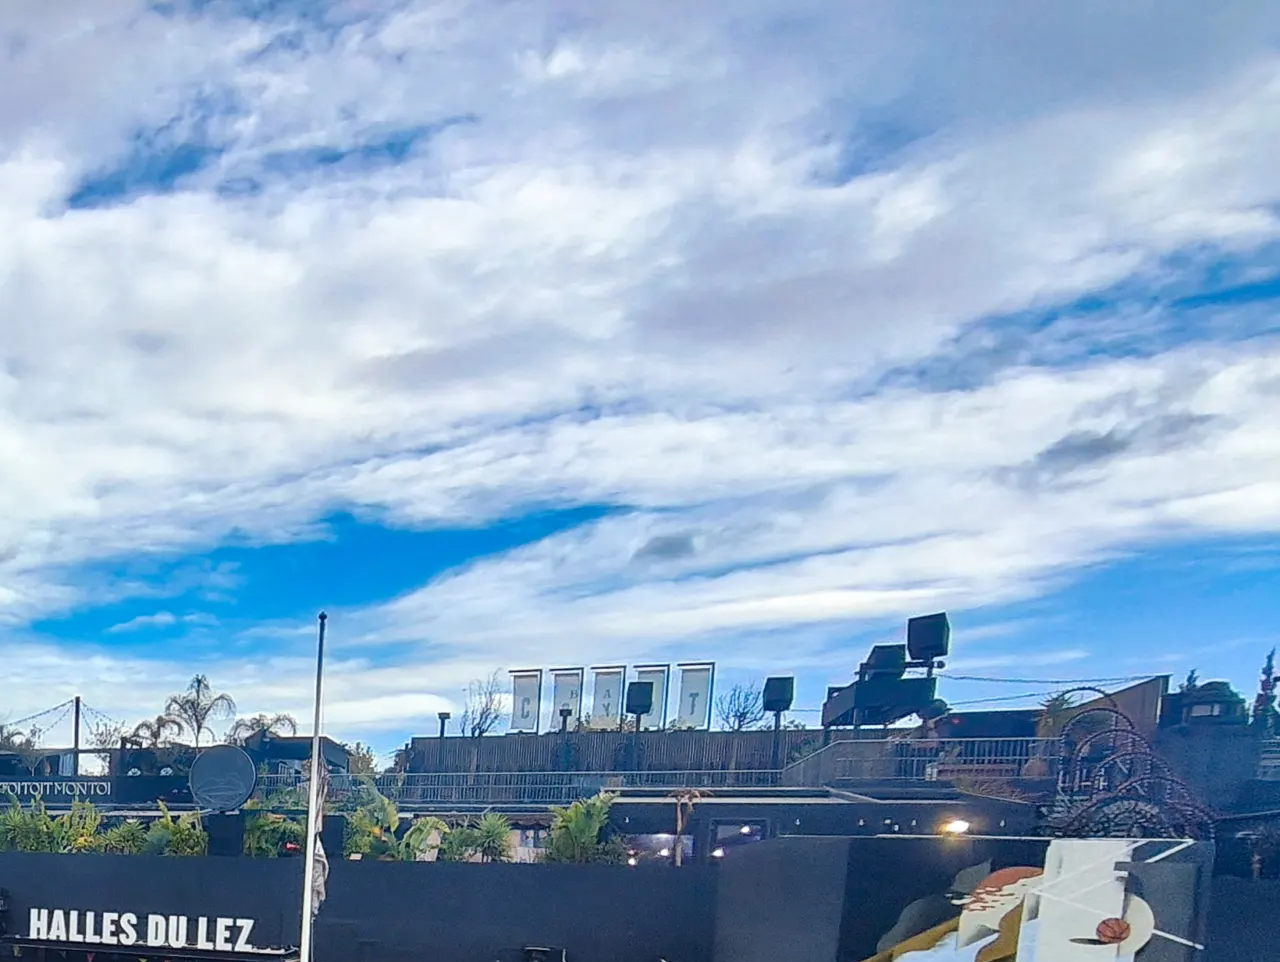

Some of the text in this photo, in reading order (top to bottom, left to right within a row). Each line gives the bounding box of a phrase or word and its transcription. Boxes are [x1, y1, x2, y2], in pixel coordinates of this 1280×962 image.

[29, 908, 255, 951] HALLES DU LEZ
